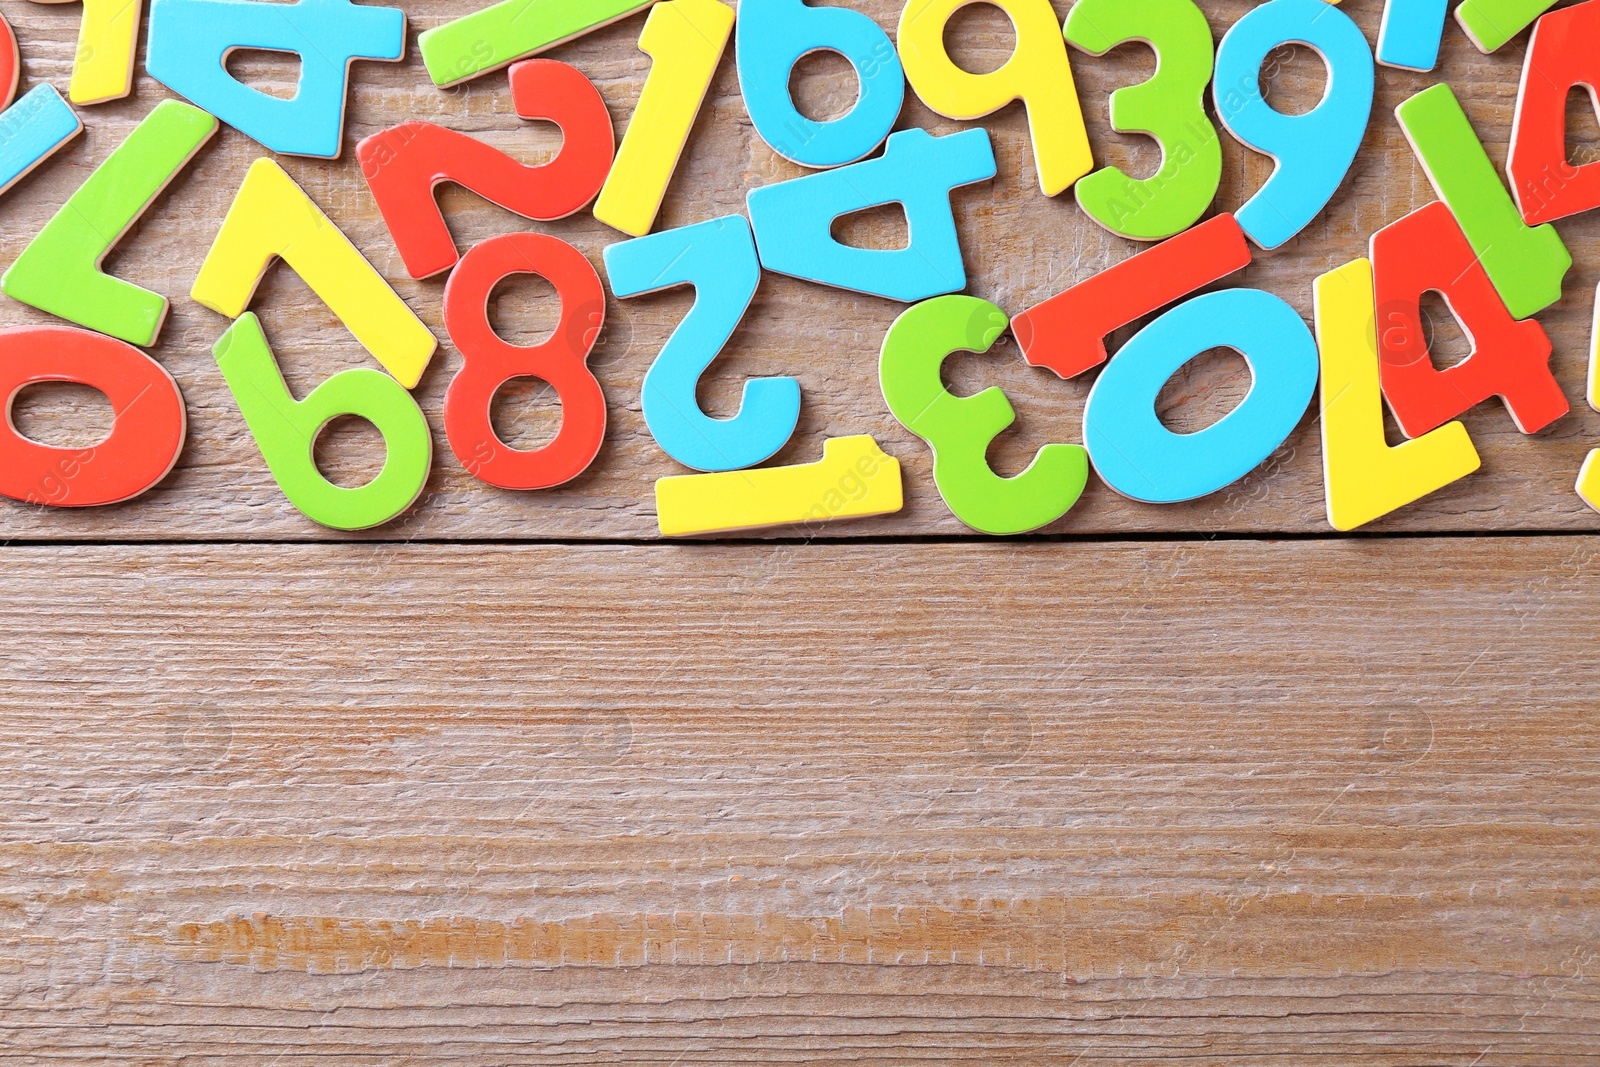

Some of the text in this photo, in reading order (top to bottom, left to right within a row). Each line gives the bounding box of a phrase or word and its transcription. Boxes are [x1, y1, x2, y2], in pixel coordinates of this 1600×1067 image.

[146, 0, 406, 158] 4
[355, 58, 616, 280] 2
[593, 0, 735, 237] 1
[736, 0, 905, 169] 6
[897, 0, 1094, 197] 9
[1063, 0, 1223, 241] 3
[1213, 0, 1375, 249] 9
[0, 99, 219, 347] 7
[189, 157, 438, 389] 7
[747, 126, 997, 304] 4
[1009, 211, 1253, 380] 1
[1369, 200, 1570, 436] 4
[1396, 83, 1573, 321] 1
[442, 232, 608, 490] 8
[603, 213, 802, 473] 2
[878, 294, 1089, 535] 3
[1082, 287, 1320, 505] 0
[1313, 257, 1481, 532] 7
[655, 435, 904, 537] 1
